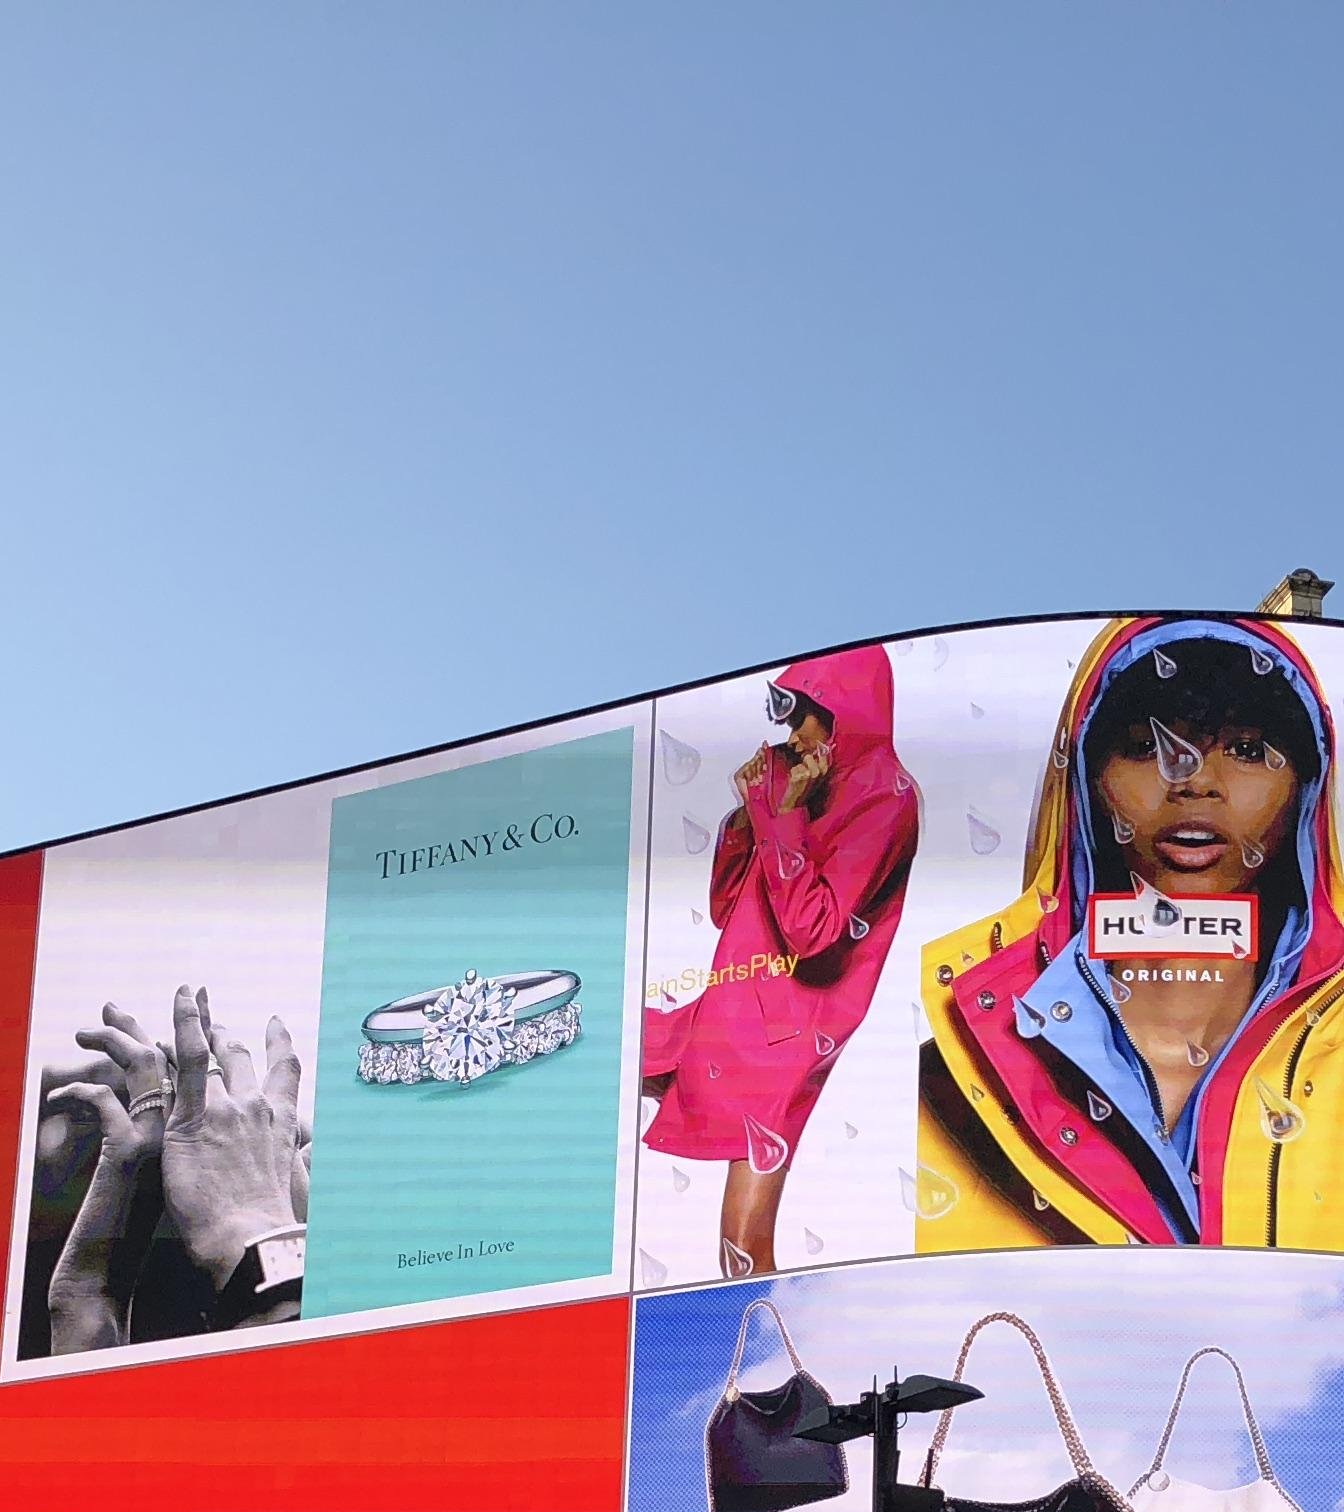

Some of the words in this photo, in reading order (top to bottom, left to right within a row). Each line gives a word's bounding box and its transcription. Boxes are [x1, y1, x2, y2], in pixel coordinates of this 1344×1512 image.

[375, 832, 499, 880] TIFFANY
[501, 824, 525, 853] &
[1102, 916, 1243, 936] HUTER
[1121, 968, 1225, 982] ORIGINAL
[396, 1250, 455, 1270] Believe
[457, 1243, 474, 1260] In
[477, 1238, 516, 1257] Love
